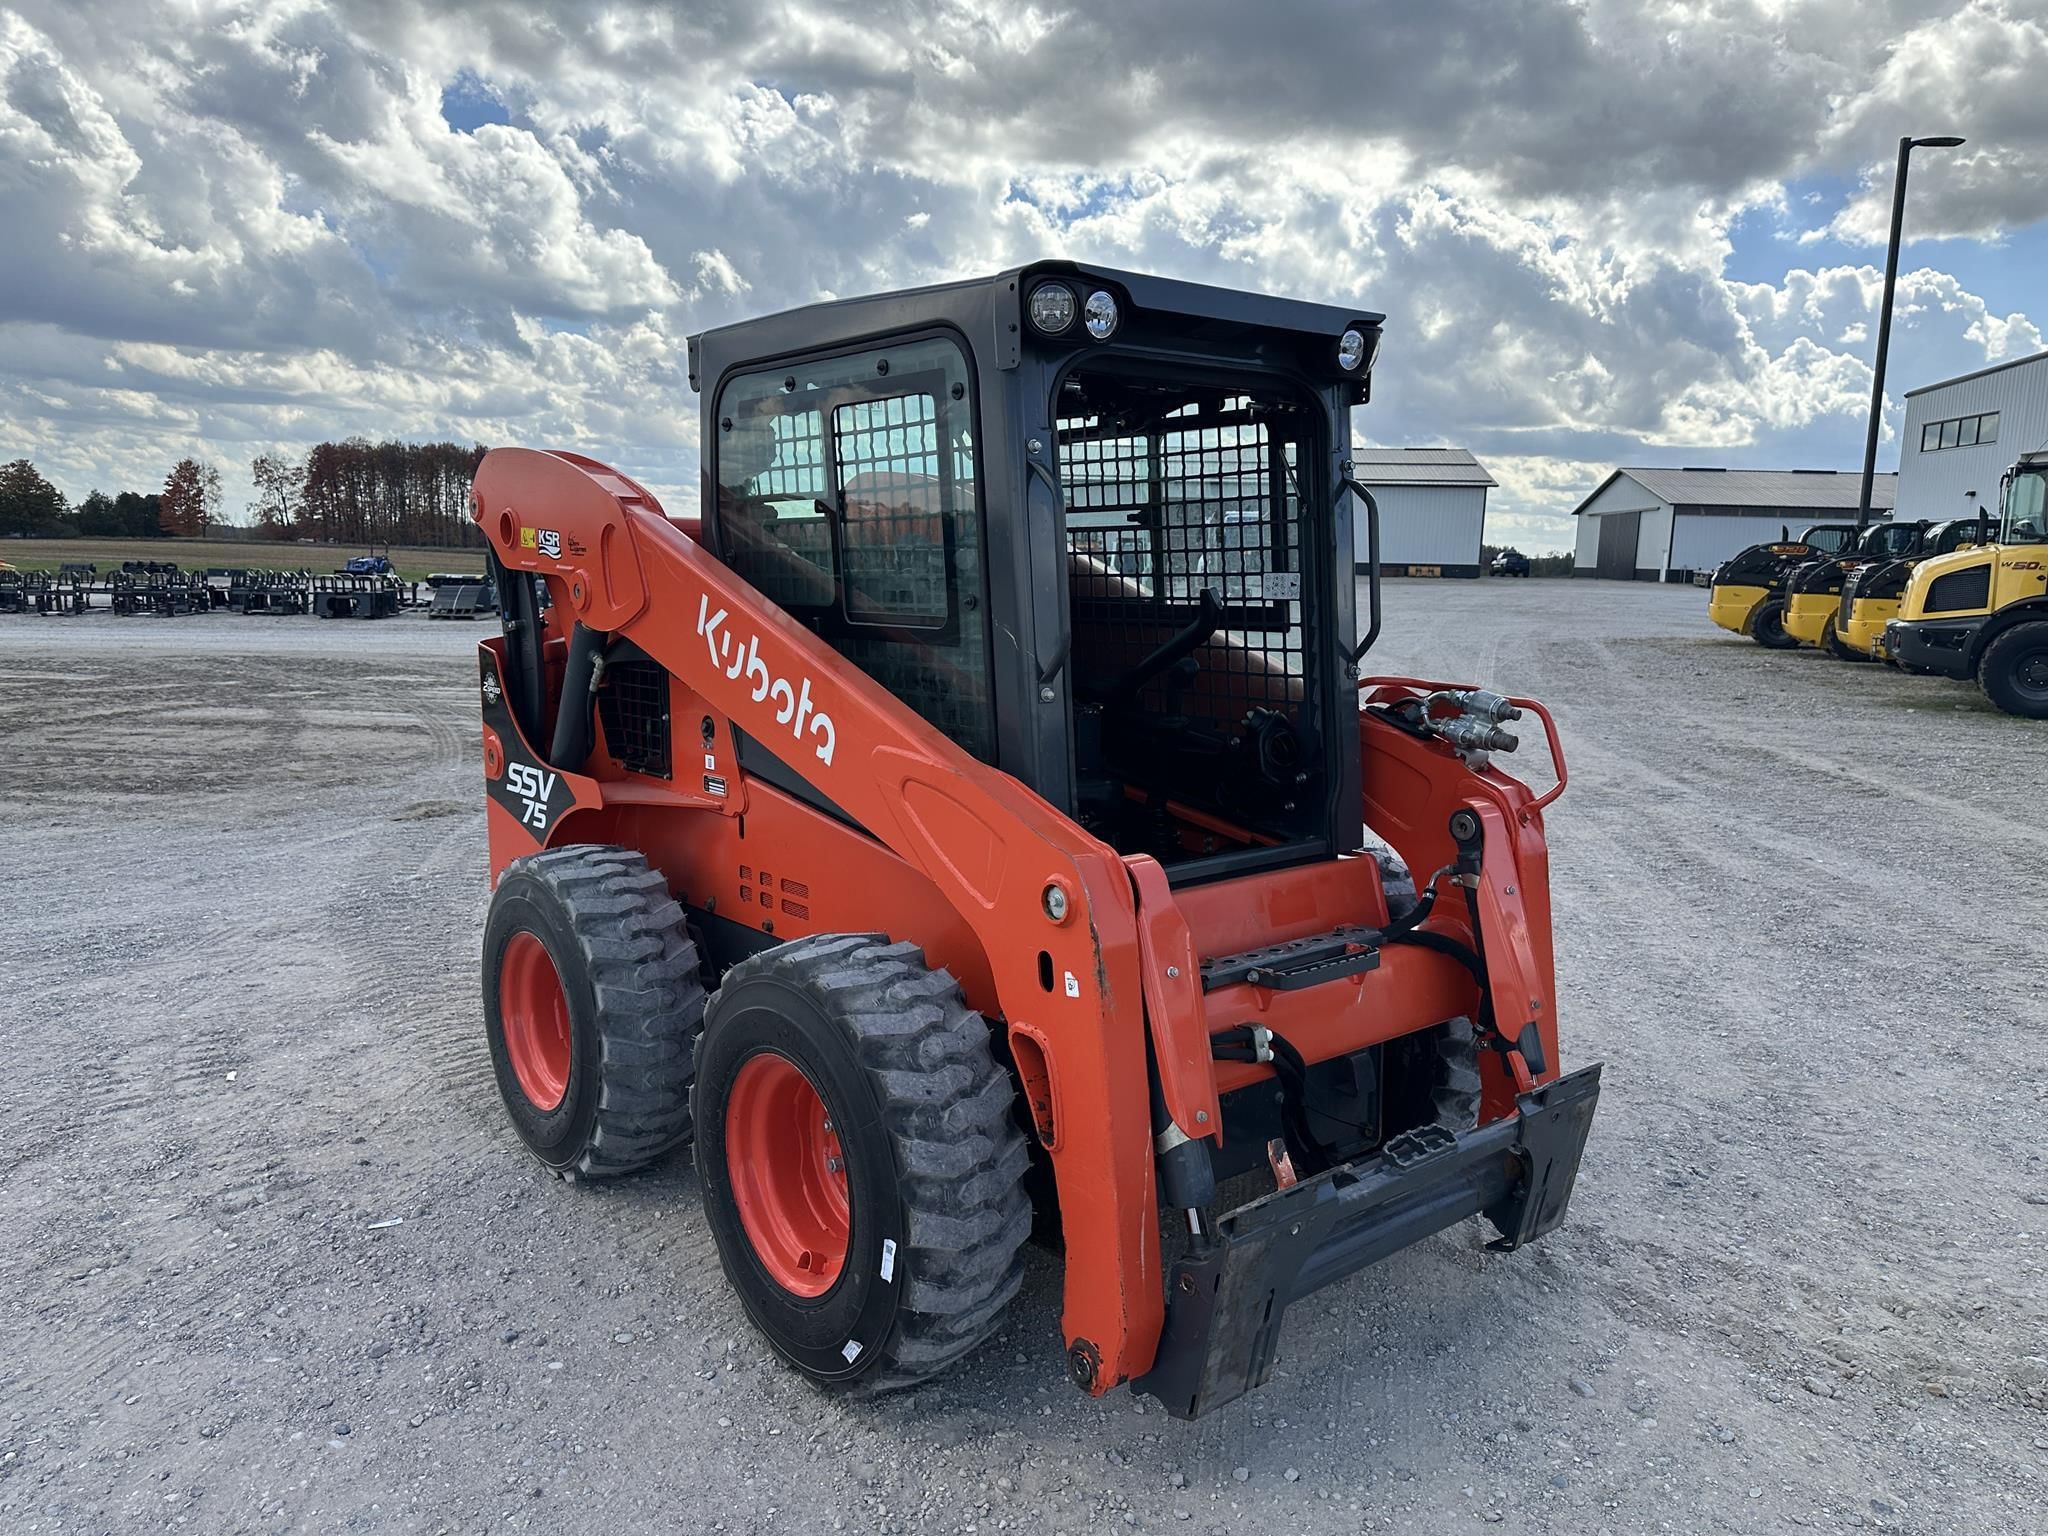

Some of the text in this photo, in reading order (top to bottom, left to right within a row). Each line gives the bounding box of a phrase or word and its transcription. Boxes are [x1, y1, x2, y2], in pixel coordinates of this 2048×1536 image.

[538, 529, 560, 547] KSR
[697, 593, 836, 767] Kubota
[506, 762, 556, 802] SSV
[522, 798, 547, 829] 75
